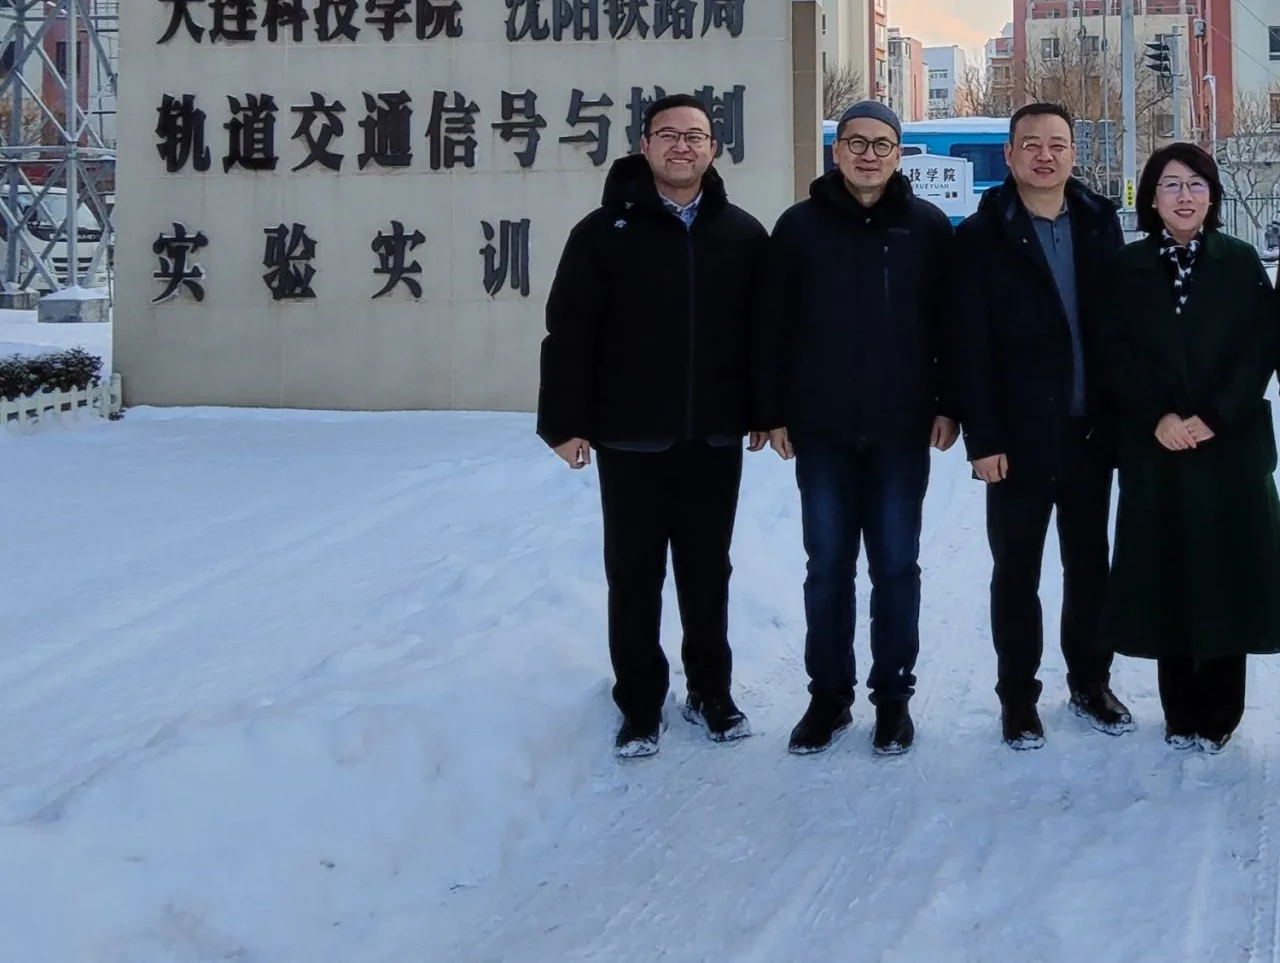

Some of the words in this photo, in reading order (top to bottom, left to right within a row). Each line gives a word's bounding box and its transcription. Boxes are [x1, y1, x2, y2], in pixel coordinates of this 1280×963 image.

[896, 168, 956, 182] 技学院
[151, 218, 531, 304] 实验实训
